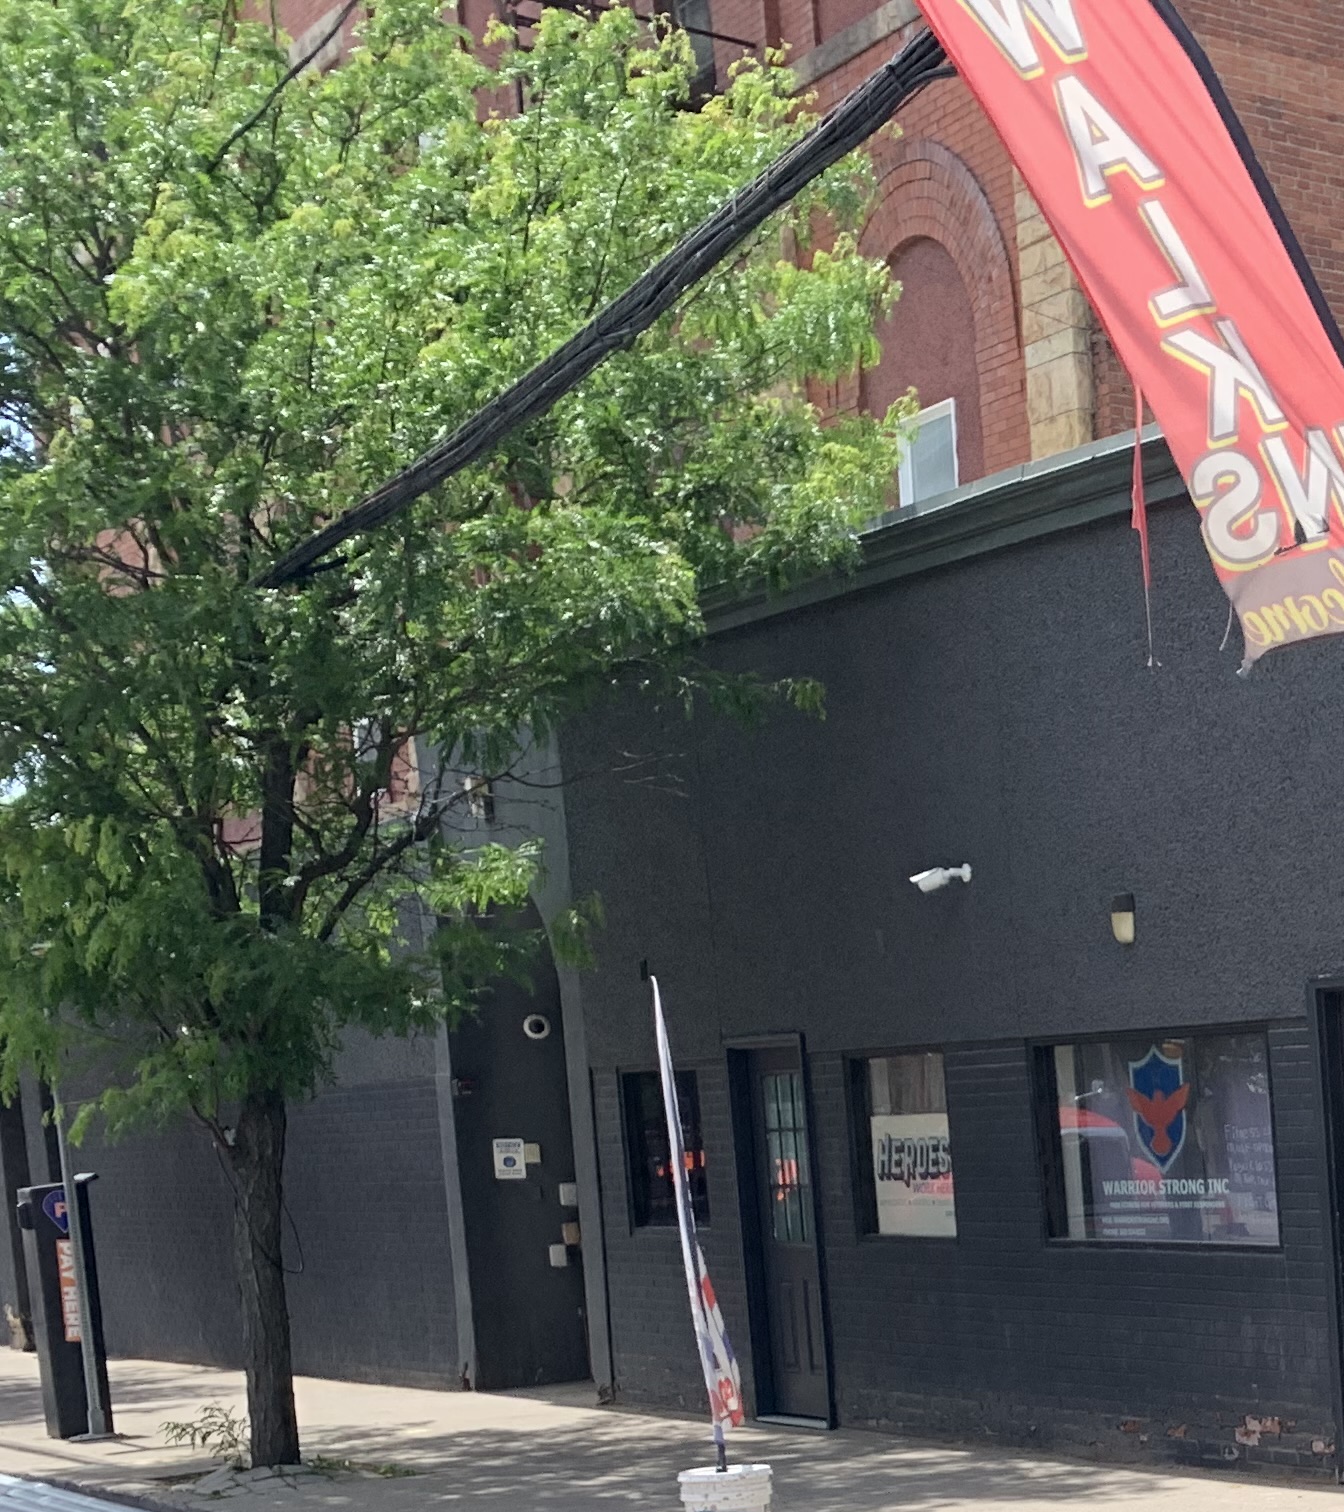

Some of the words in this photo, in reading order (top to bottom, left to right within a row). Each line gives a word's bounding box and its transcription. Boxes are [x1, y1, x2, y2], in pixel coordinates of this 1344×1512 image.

[878, 1133, 952, 1188] HEROES
[1102, 1180, 1157, 1196] WARRIOR
[1158, 1179, 1205, 1195] STRONG
[1207, 1178, 1230, 1194] INC
